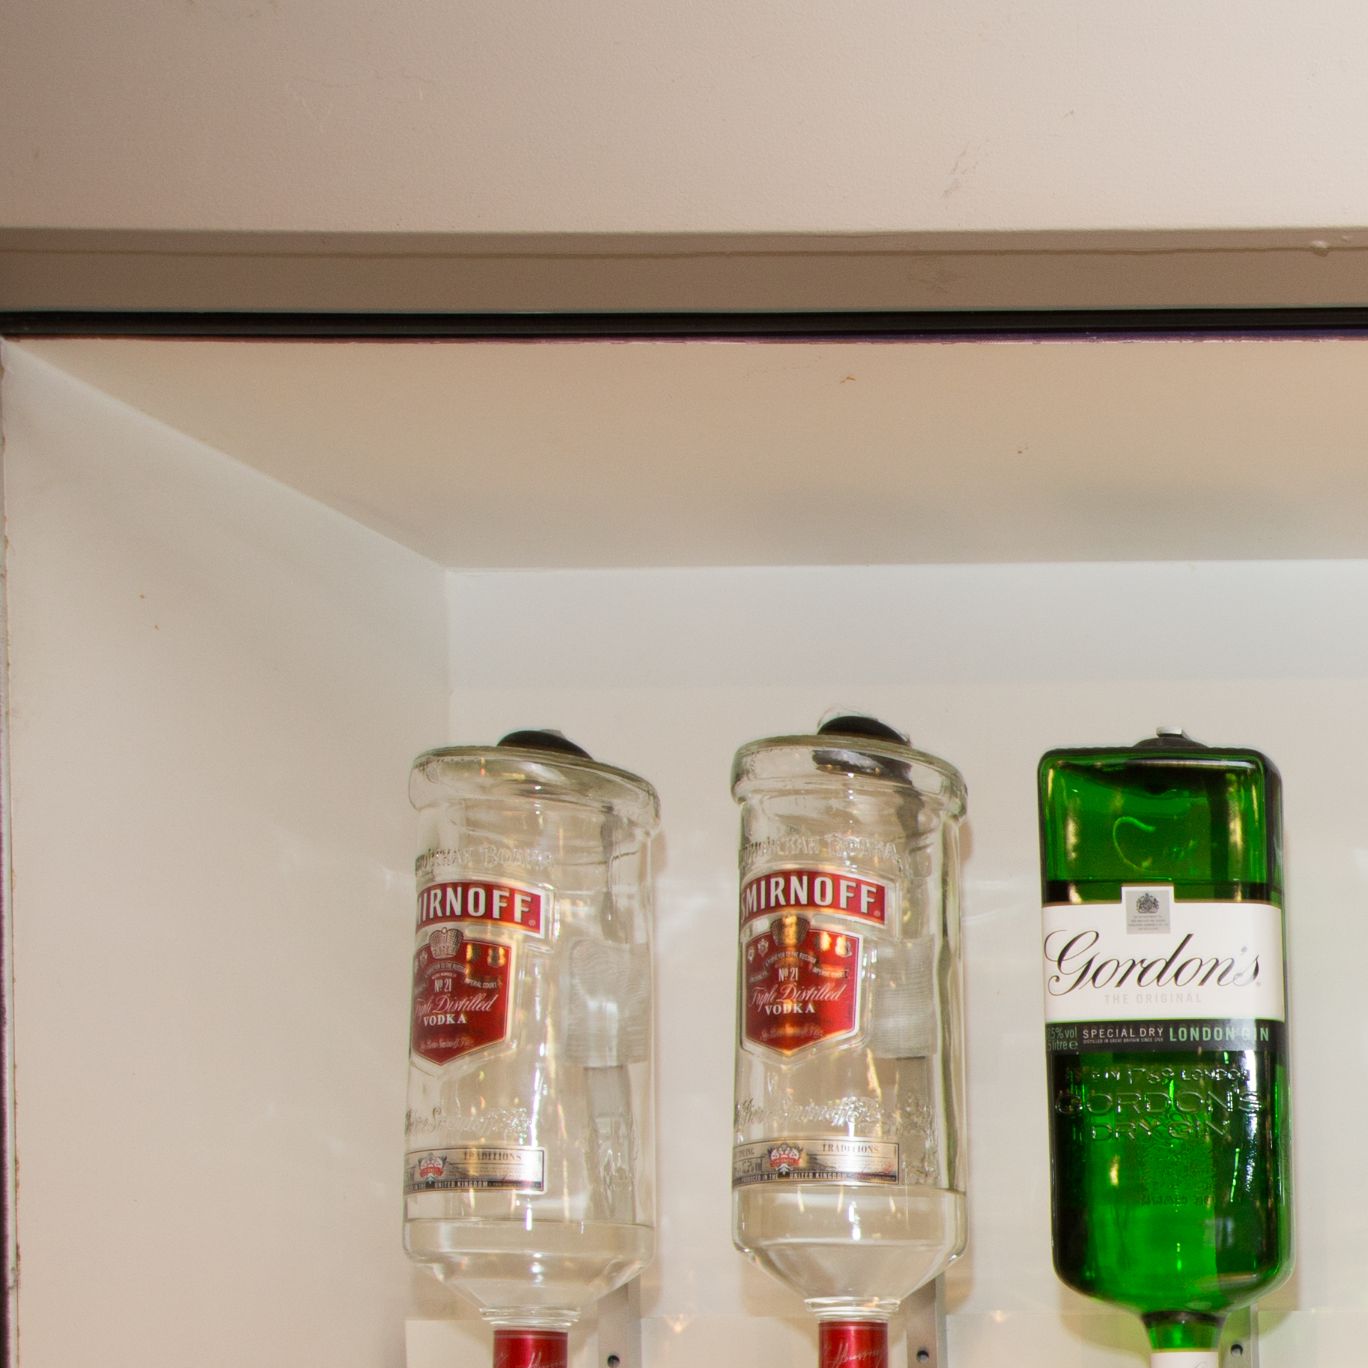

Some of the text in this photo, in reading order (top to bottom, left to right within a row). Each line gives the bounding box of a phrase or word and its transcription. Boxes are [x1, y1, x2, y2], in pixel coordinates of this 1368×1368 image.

[1043, 929, 1260, 997] Gordon's
[776, 981, 847, 1002] Distilled
[1105, 993, 1129, 1005] THE
[765, 1003, 815, 1016] VODKA
[423, 1013, 467, 1027] VODKA
[1082, 1027, 1164, 1039] SPECIAL DRY
[1169, 1027, 1270, 1042] LONDON GIN
